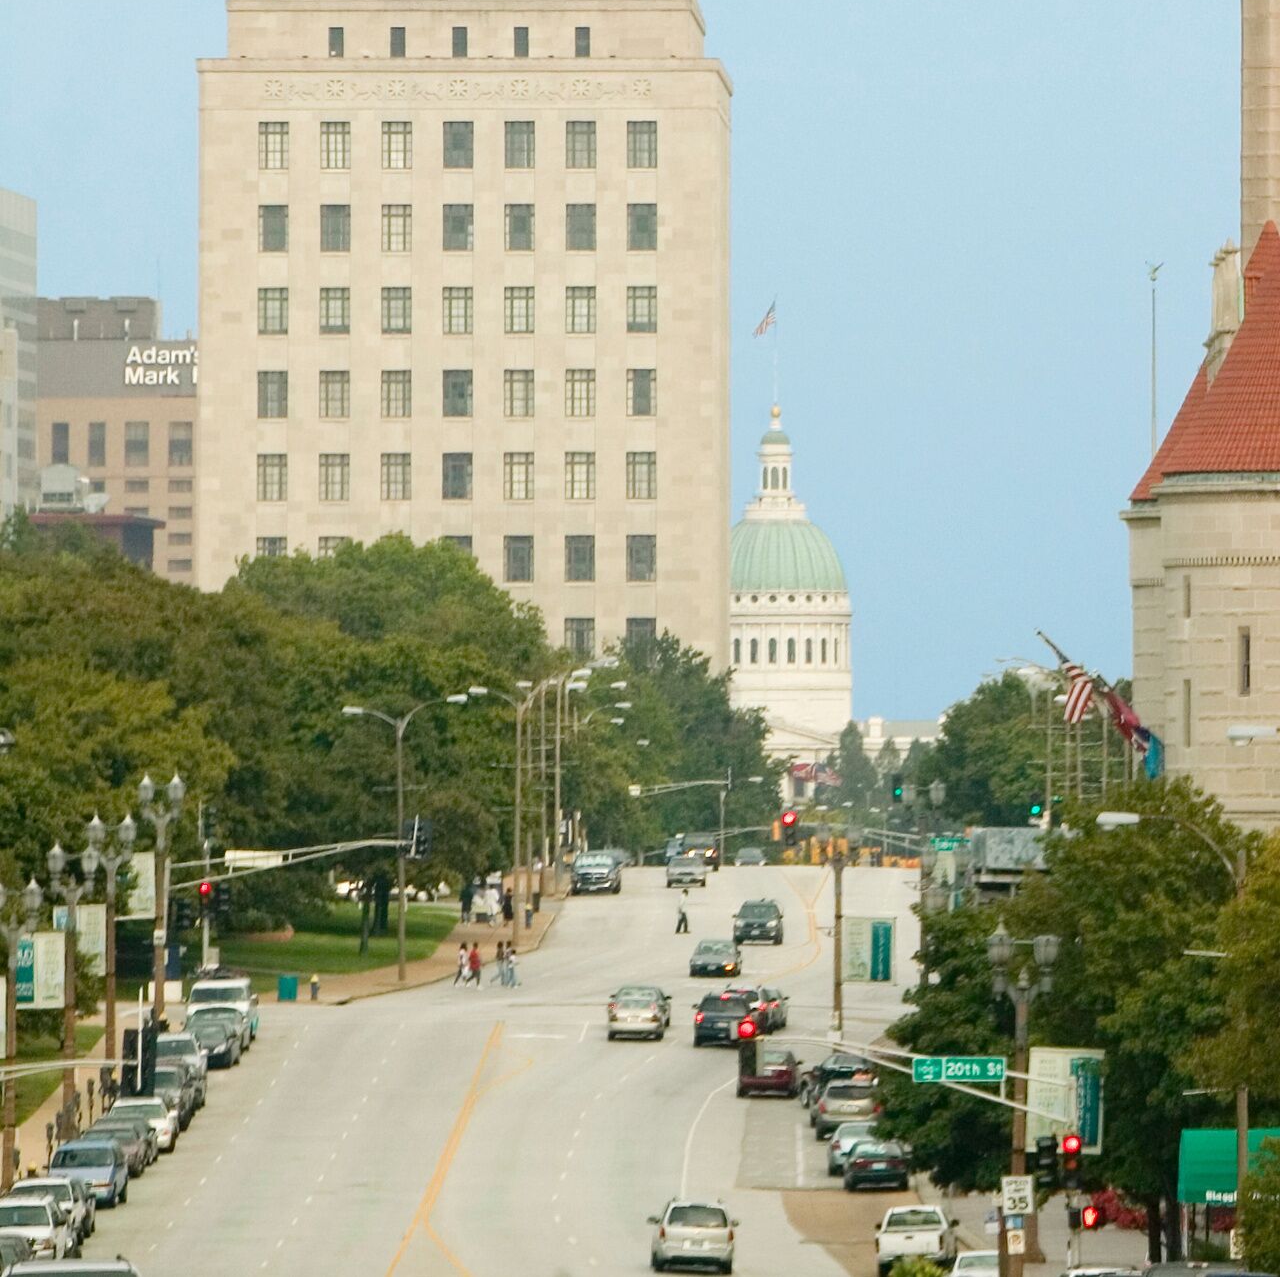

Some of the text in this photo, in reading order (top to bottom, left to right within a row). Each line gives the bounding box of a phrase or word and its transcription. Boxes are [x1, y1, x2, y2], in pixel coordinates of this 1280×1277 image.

[125, 365, 180, 385] Mark
[946, 1062, 981, 1076] 20th
[987, 1062, 1004, 1076] St
[1007, 1195, 1029, 1210] 35
